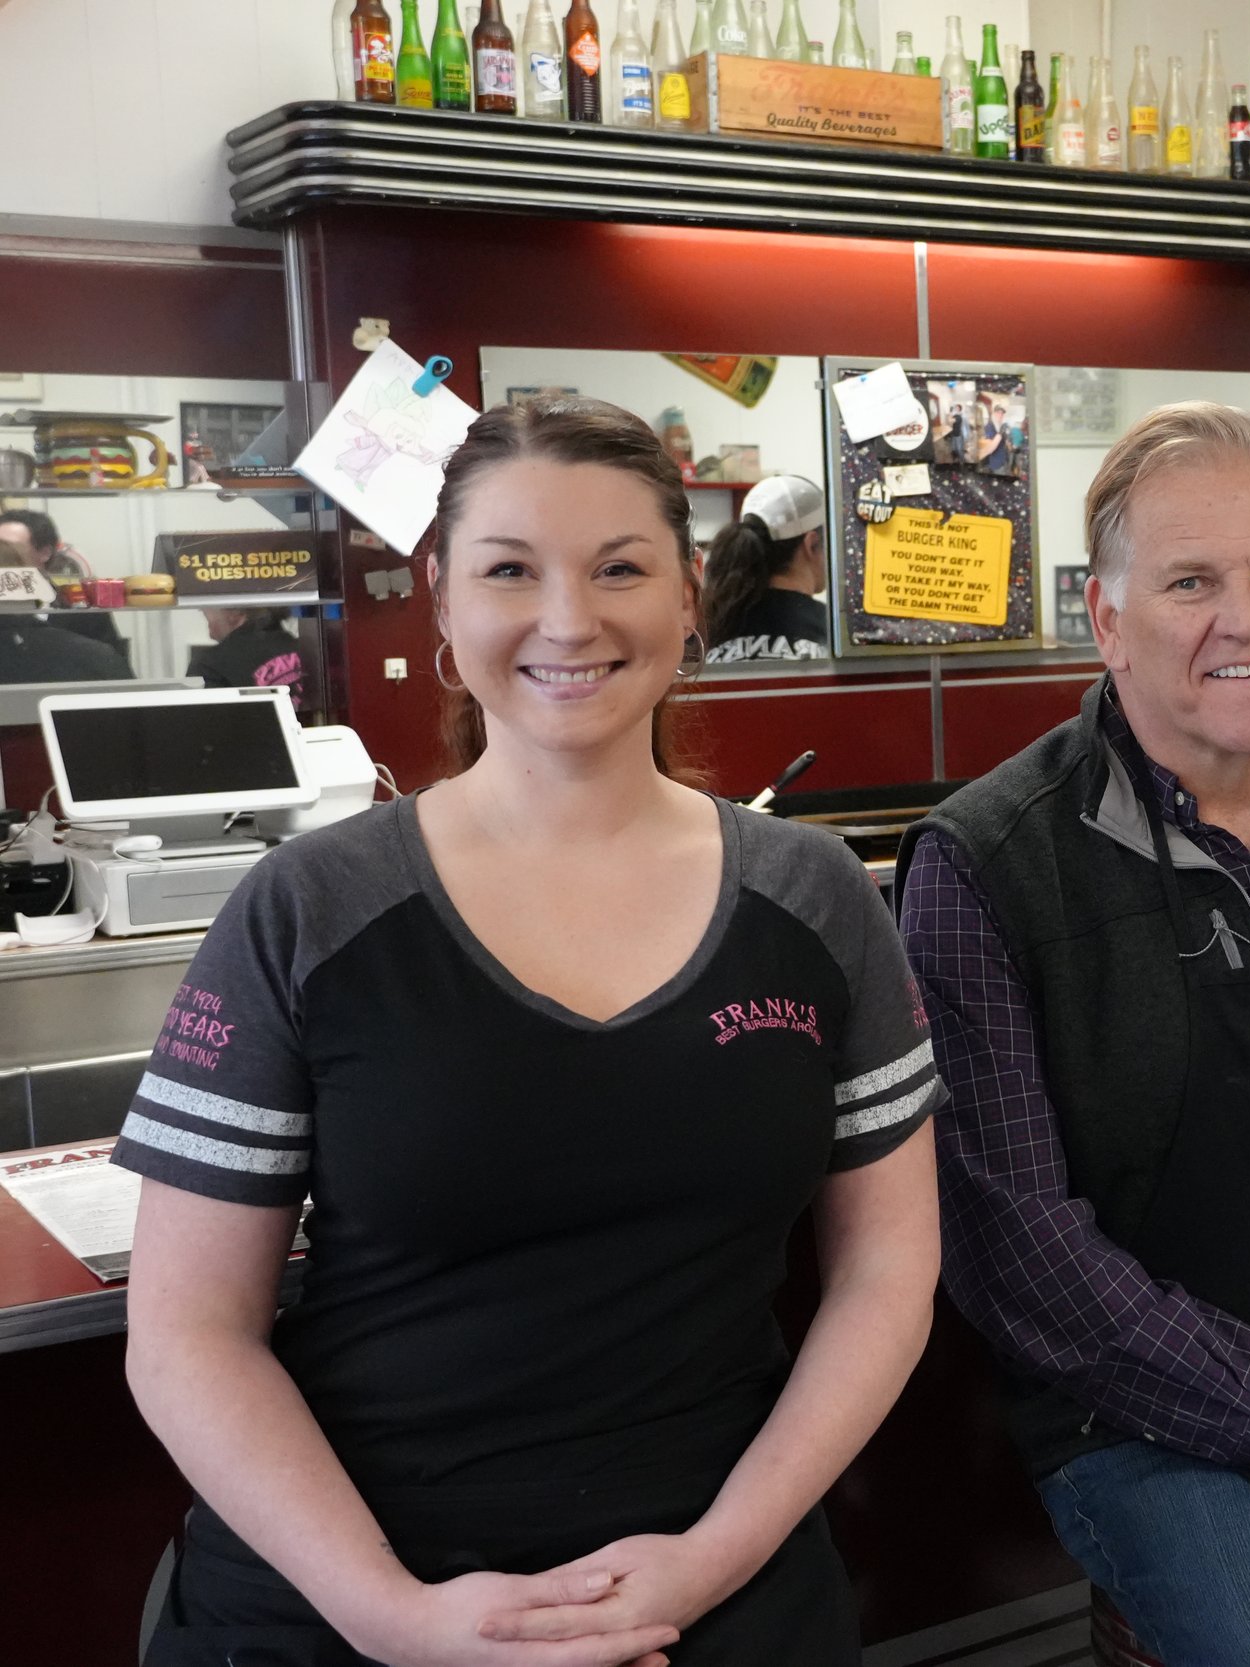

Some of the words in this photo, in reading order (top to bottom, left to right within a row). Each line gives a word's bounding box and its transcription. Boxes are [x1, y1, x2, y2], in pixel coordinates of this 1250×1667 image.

[717, 25, 748, 42] Coke
[798, 104, 822, 116] IT'S
[829, 107, 853, 118] THE
[857, 110, 892, 121] BEST
[766, 112, 818, 131] Quality
[820, 118, 897, 137] Beverages
[859, 485, 892, 504] EAT
[908, 519, 932, 529] THIS
[947, 524, 970, 534] NOT
[897, 530, 944, 547] BURGER
[948, 537, 978, 551] KING
[178, 553, 203, 569] $1
[206, 553, 243, 567] FOR
[246, 550, 311, 566] STUPID
[890, 549, 912, 560] YOU
[914, 552, 947, 564] DON'T
[949, 557, 971, 567] GET
[973, 560, 985, 568] IT
[195, 565, 298, 582] QUESTIONS
[908, 563, 937, 574] YOUR
[940, 568, 965, 578] WAY.
[880, 572, 902, 582] YOU
[905, 575, 931, 586] TAKE
[934, 578, 945, 587] IT
[947, 580, 965, 589] MY
[967, 582, 992, 593] WAY,
[885, 584, 902, 594] OR
[904, 587, 926, 597] YOU
[928, 590, 961, 600] DON'T
[963, 593, 985, 603] GET
[888, 596, 908, 606] THE
[910, 600, 942, 610] DAMN
[945, 603, 981, 614] THING.
[192, 989, 222, 1016] 1924
[709, 997, 817, 1031] FRANK'S
[178, 1010, 235, 1048] YEARS
[715, 1025, 740, 1046] BEST
[742, 1016, 788, 1031] BURGERS
[169, 1040, 220, 1072] COUNTING
